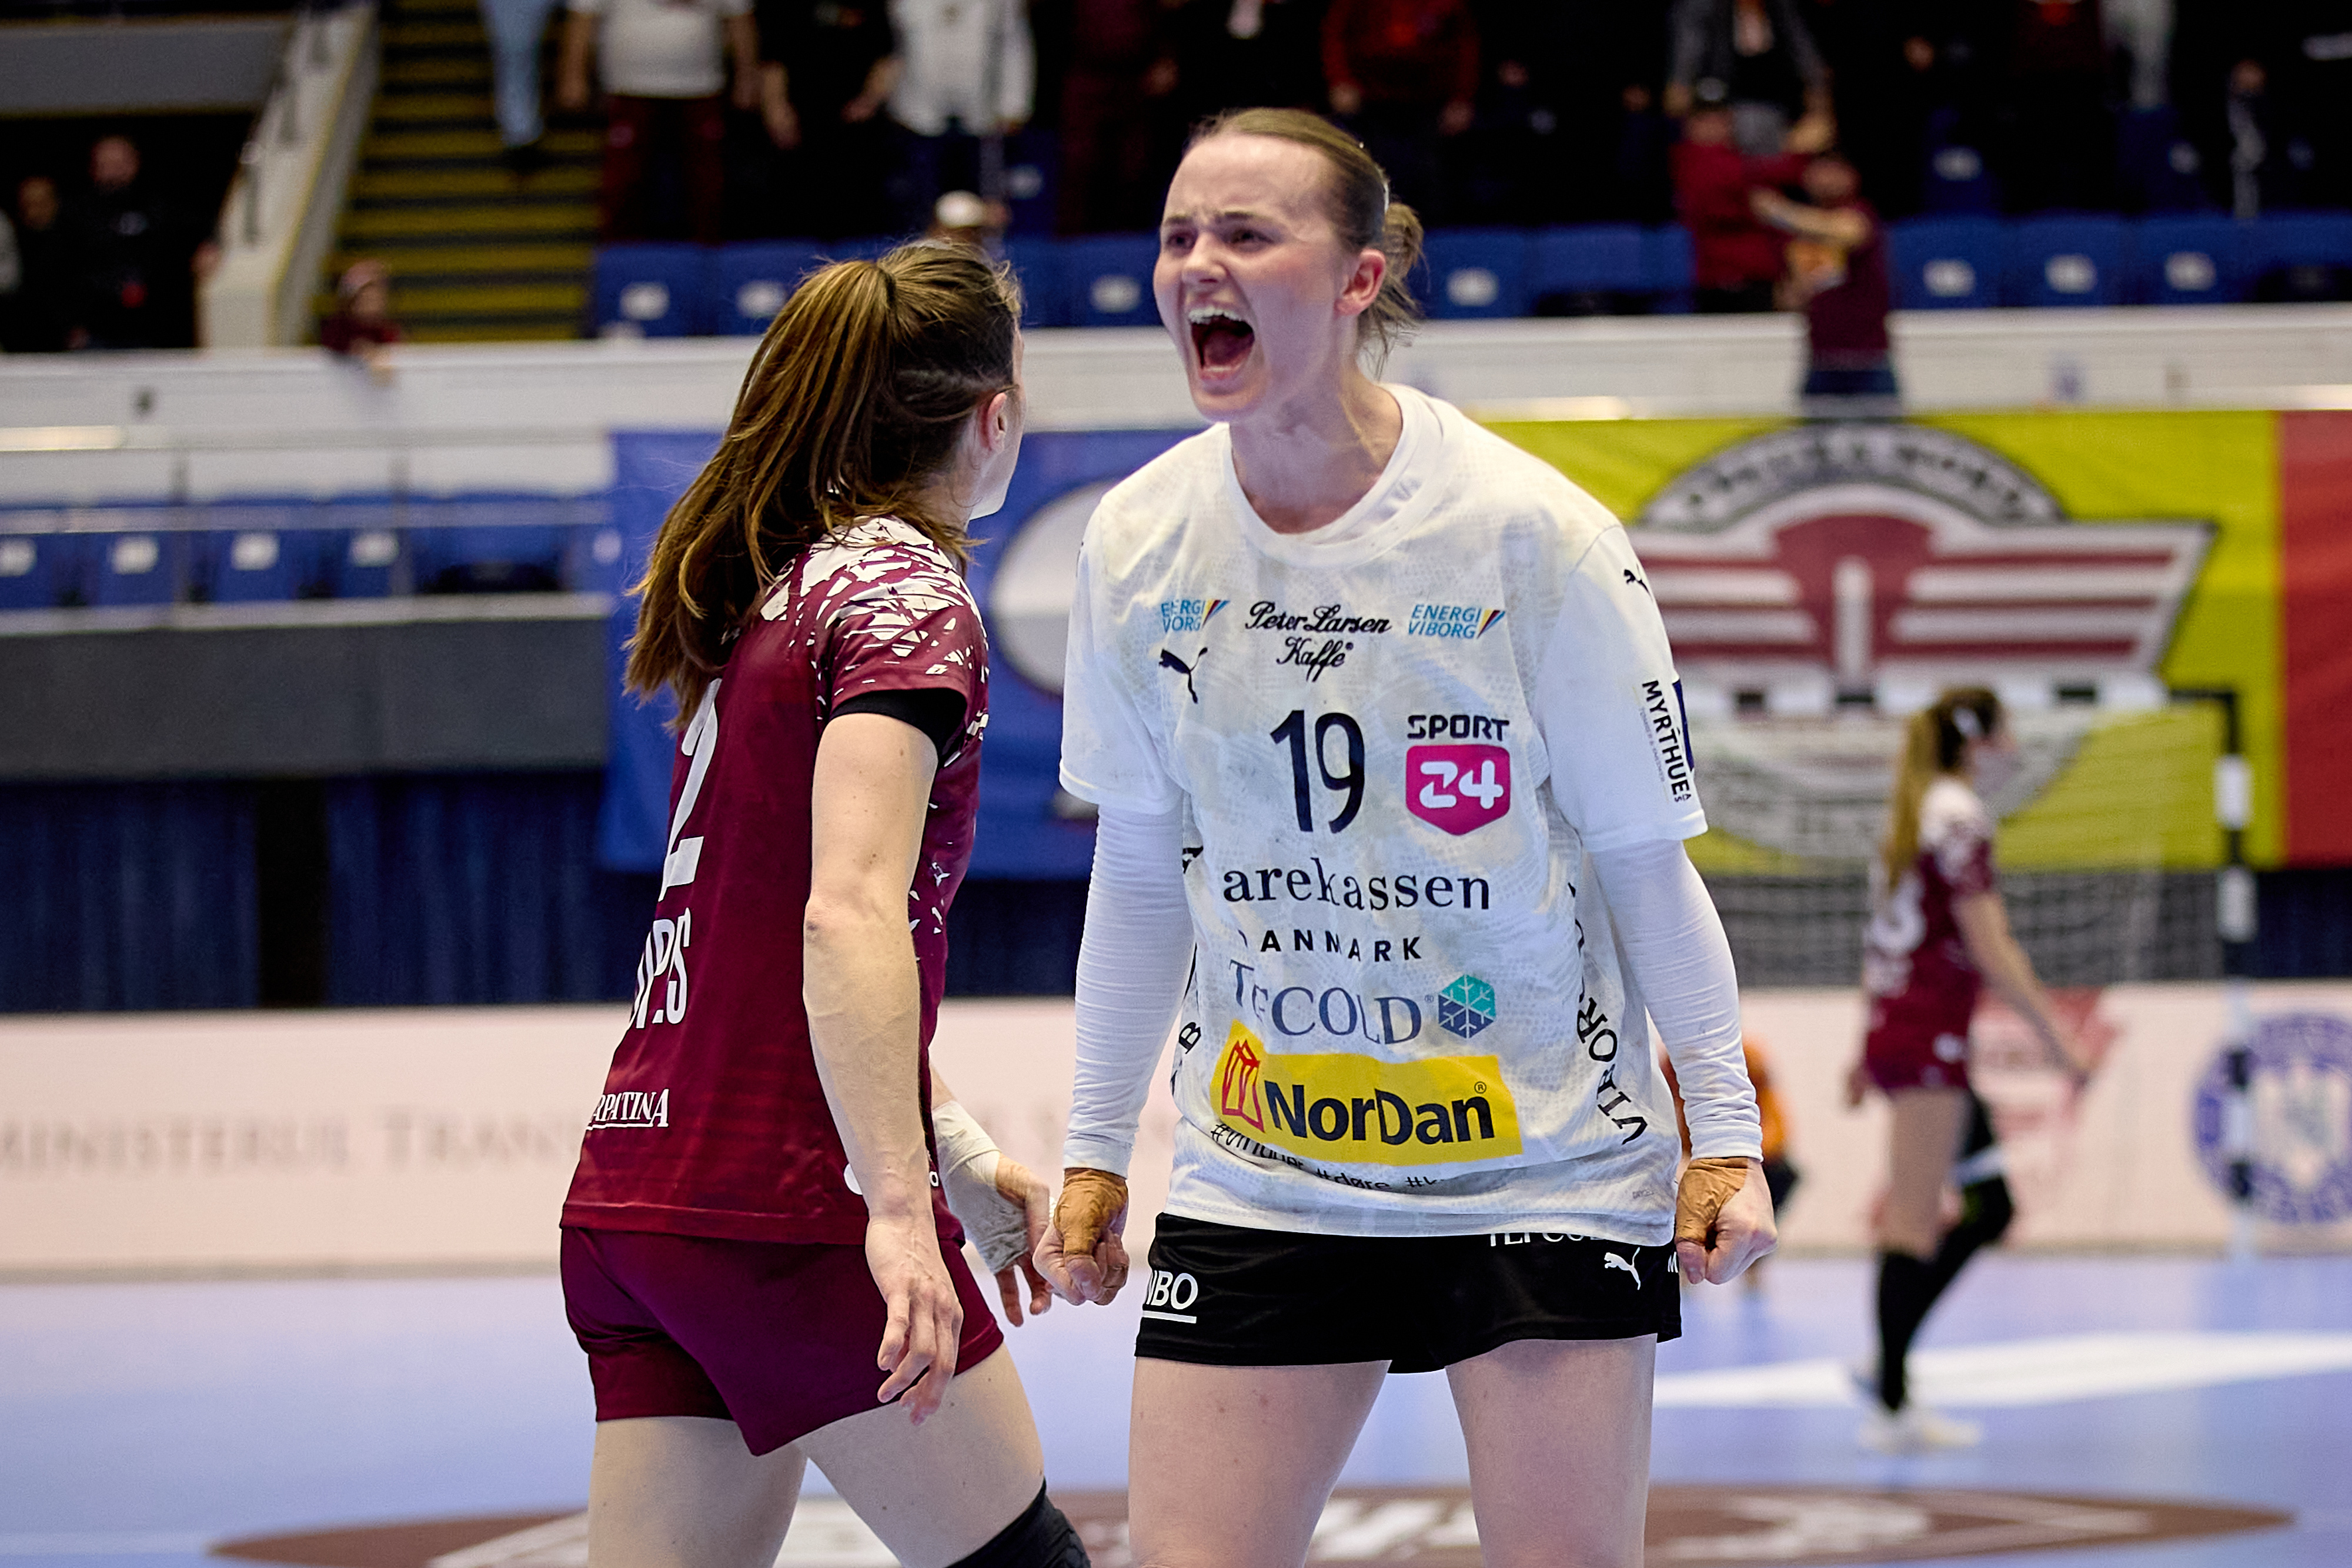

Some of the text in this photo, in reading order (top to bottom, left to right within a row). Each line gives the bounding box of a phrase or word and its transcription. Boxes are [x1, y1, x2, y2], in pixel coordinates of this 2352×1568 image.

[1245, 601, 1392, 633] Peter Larsen
[1408, 621, 1477, 639] VIBORG
[1411, 604, 1482, 623] ENERGI
[1407, 715, 1509, 741] SPORT
[1642, 680, 1690, 795] MYRTHUE
[1270, 710, 1365, 834] 19
[1419, 760, 1504, 808] 24
[1223, 857, 1489, 910] arekassen
[1577, 976, 1648, 1145] VIBOR
[590, 1089, 669, 1128] RPATINA
[1264, 1080, 1495, 1145] NorDan
